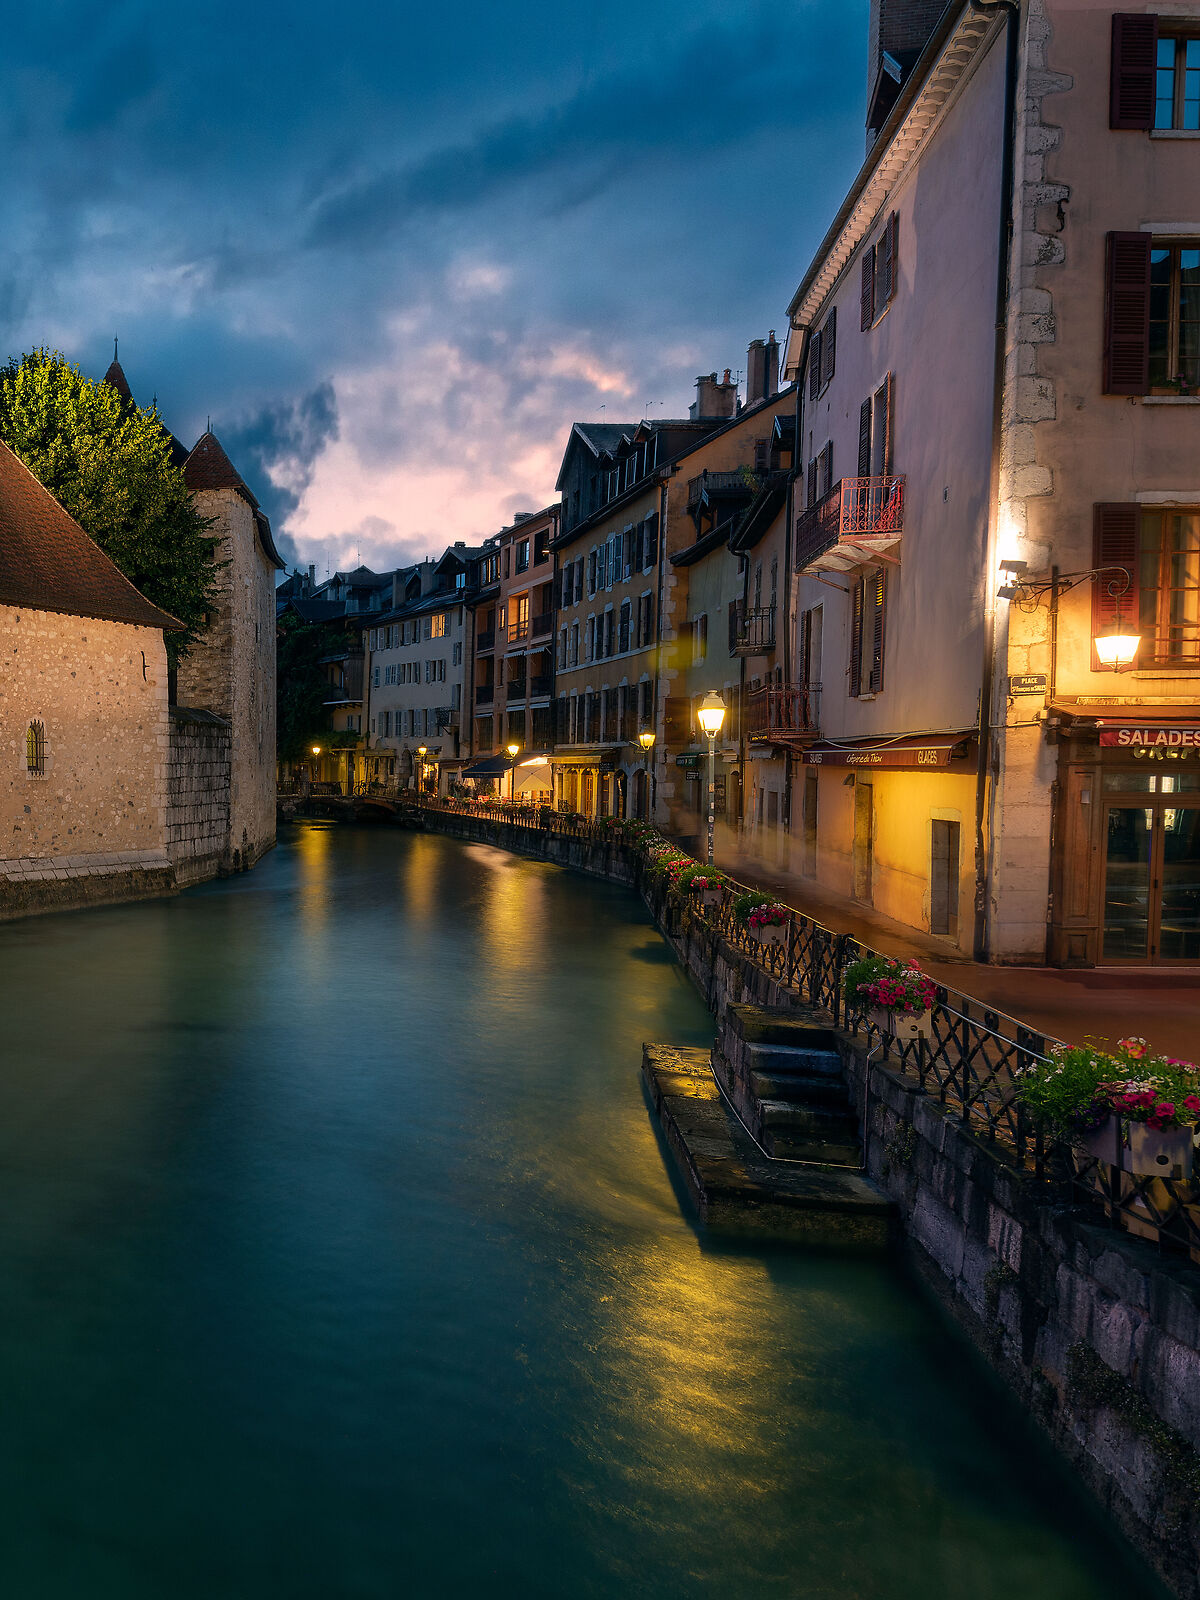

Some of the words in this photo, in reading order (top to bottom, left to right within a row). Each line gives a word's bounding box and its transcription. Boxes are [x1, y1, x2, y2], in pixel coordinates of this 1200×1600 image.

[1117, 729, 1200, 746] SALADES
[917, 750, 938, 764] GLACES
[1133, 746, 1200, 760] CREP
